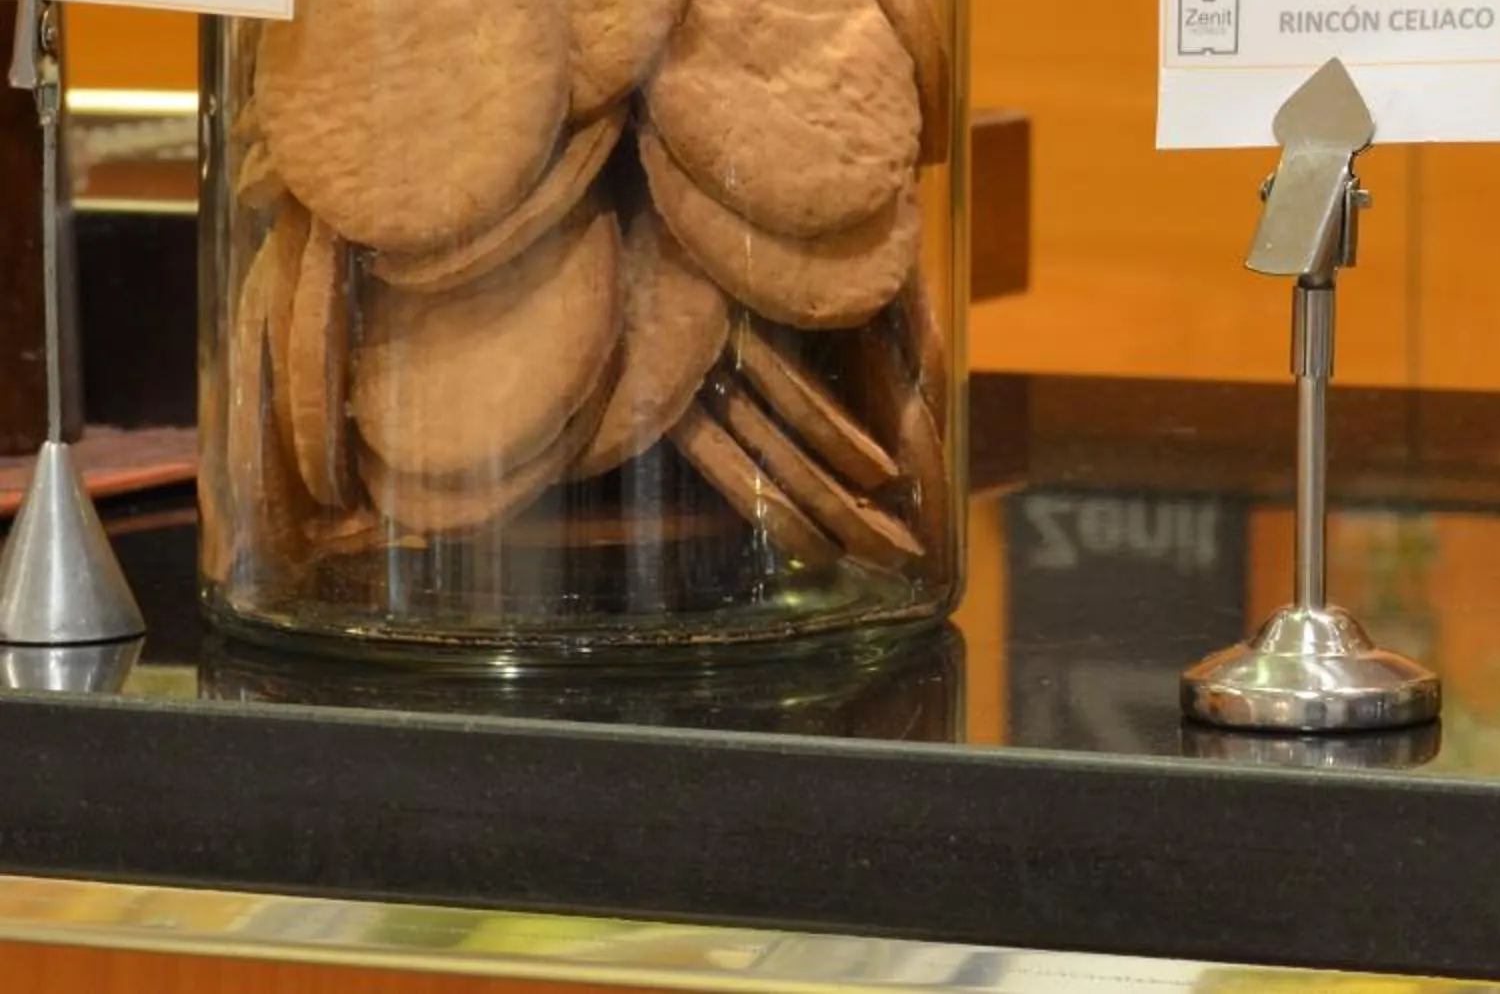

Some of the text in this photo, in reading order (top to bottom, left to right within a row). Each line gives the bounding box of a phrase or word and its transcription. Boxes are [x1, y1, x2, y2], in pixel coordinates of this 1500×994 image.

[1185, 8, 1231, 27] Zenit
[1279, 5, 1495, 34] RINCÓN CELIACO
